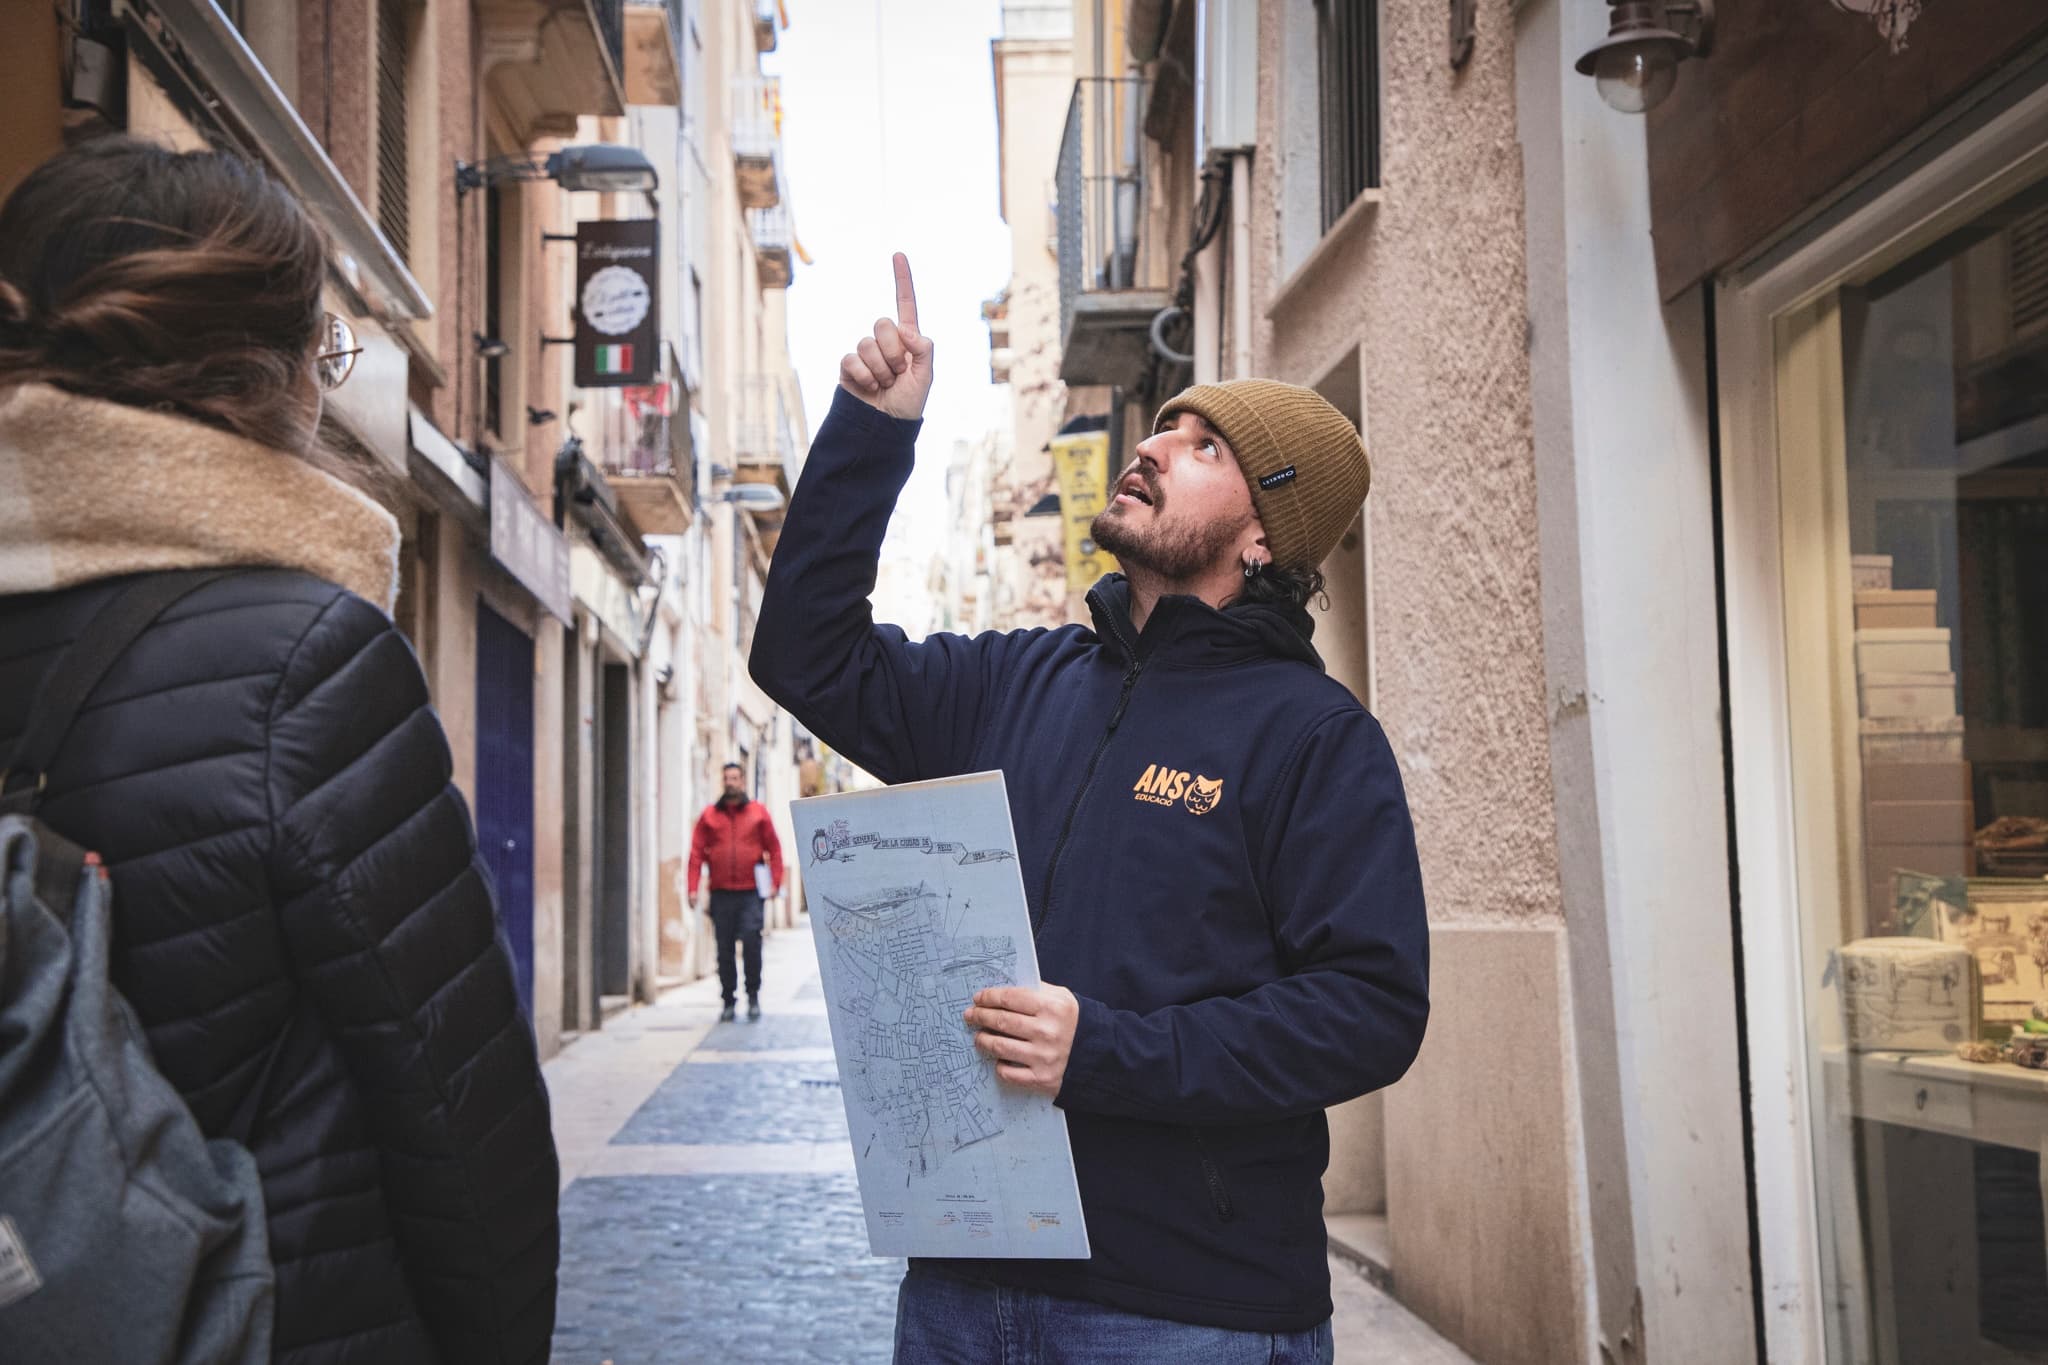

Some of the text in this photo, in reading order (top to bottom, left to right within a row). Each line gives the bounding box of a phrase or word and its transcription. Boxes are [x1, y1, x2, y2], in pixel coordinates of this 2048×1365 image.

[1133, 764, 1191, 799] ANS
[853, 834, 878, 847] GENERAL
[881, 839, 890, 848] DE
[890, 839, 899, 848] LA
[900, 838, 921, 848] CIUDAD
[922, 838, 930, 847] DE
